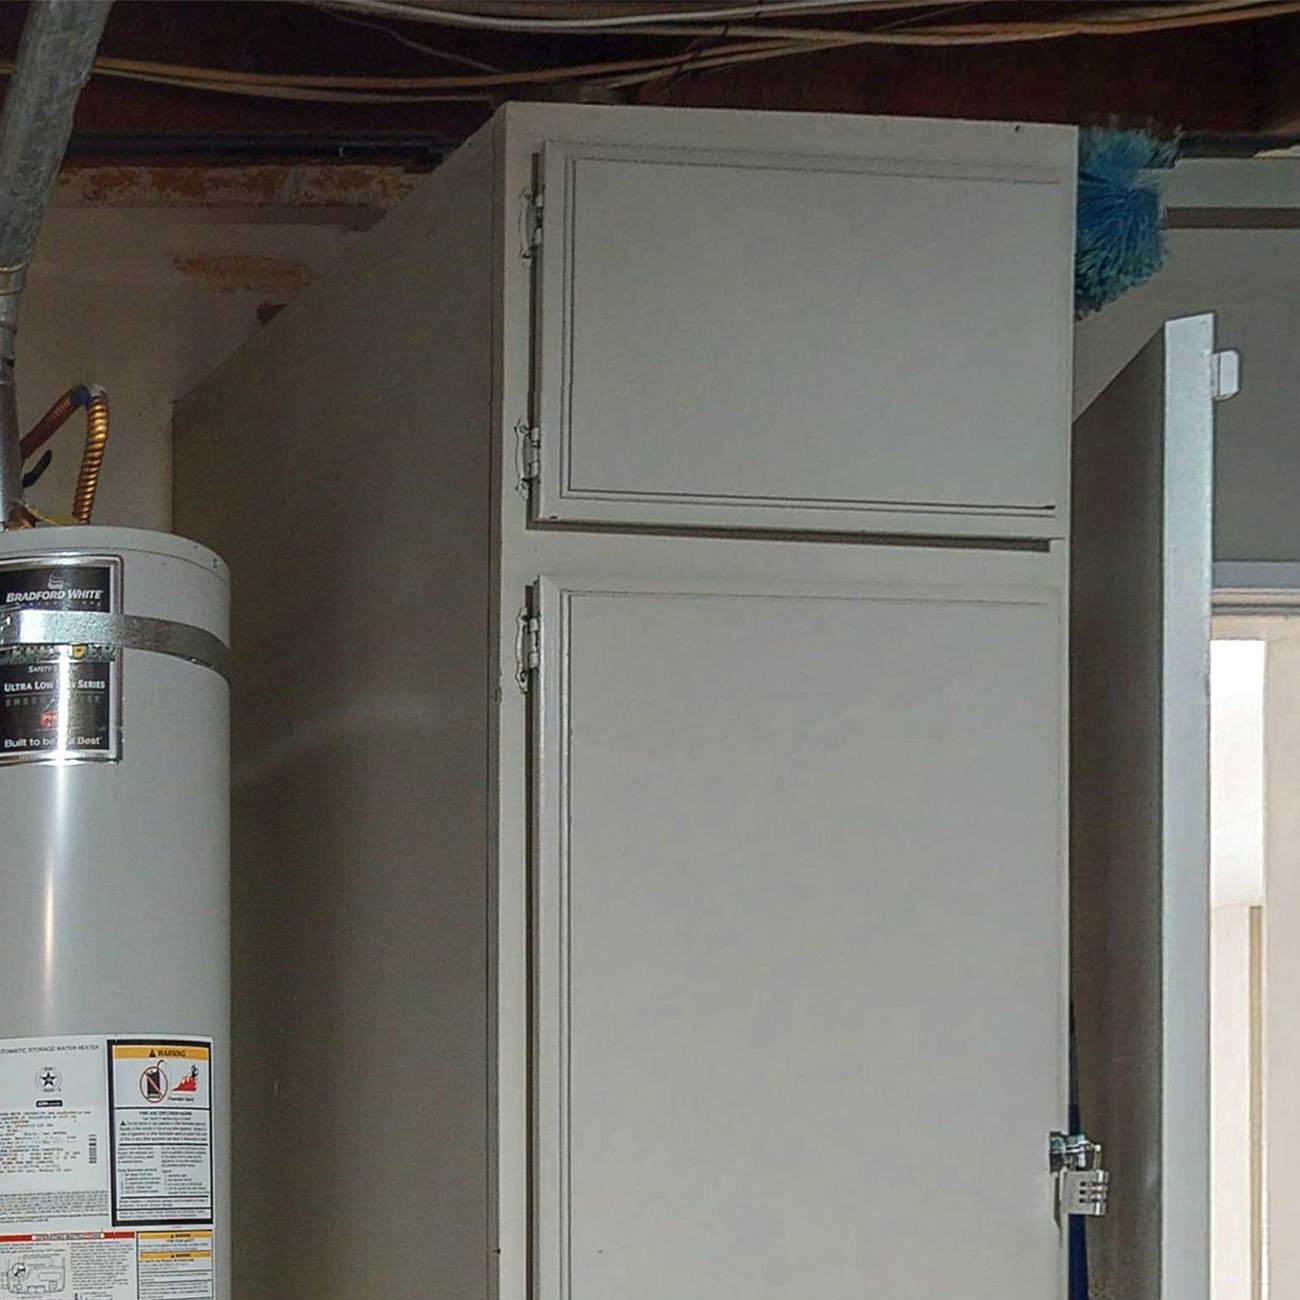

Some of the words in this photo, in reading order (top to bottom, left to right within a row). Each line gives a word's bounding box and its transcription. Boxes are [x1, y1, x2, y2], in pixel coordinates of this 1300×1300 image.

[6, 590, 66, 603] BRADFORD
[67, 589, 103, 600] WHITE
[4, 682, 32, 692] ULTRA
[34, 681, 54, 690] LOW
[78, 680, 106, 689] SERIES
[4, 738, 27, 748] Built
[29, 738, 40, 746] to
[77, 736, 101, 745] Best
